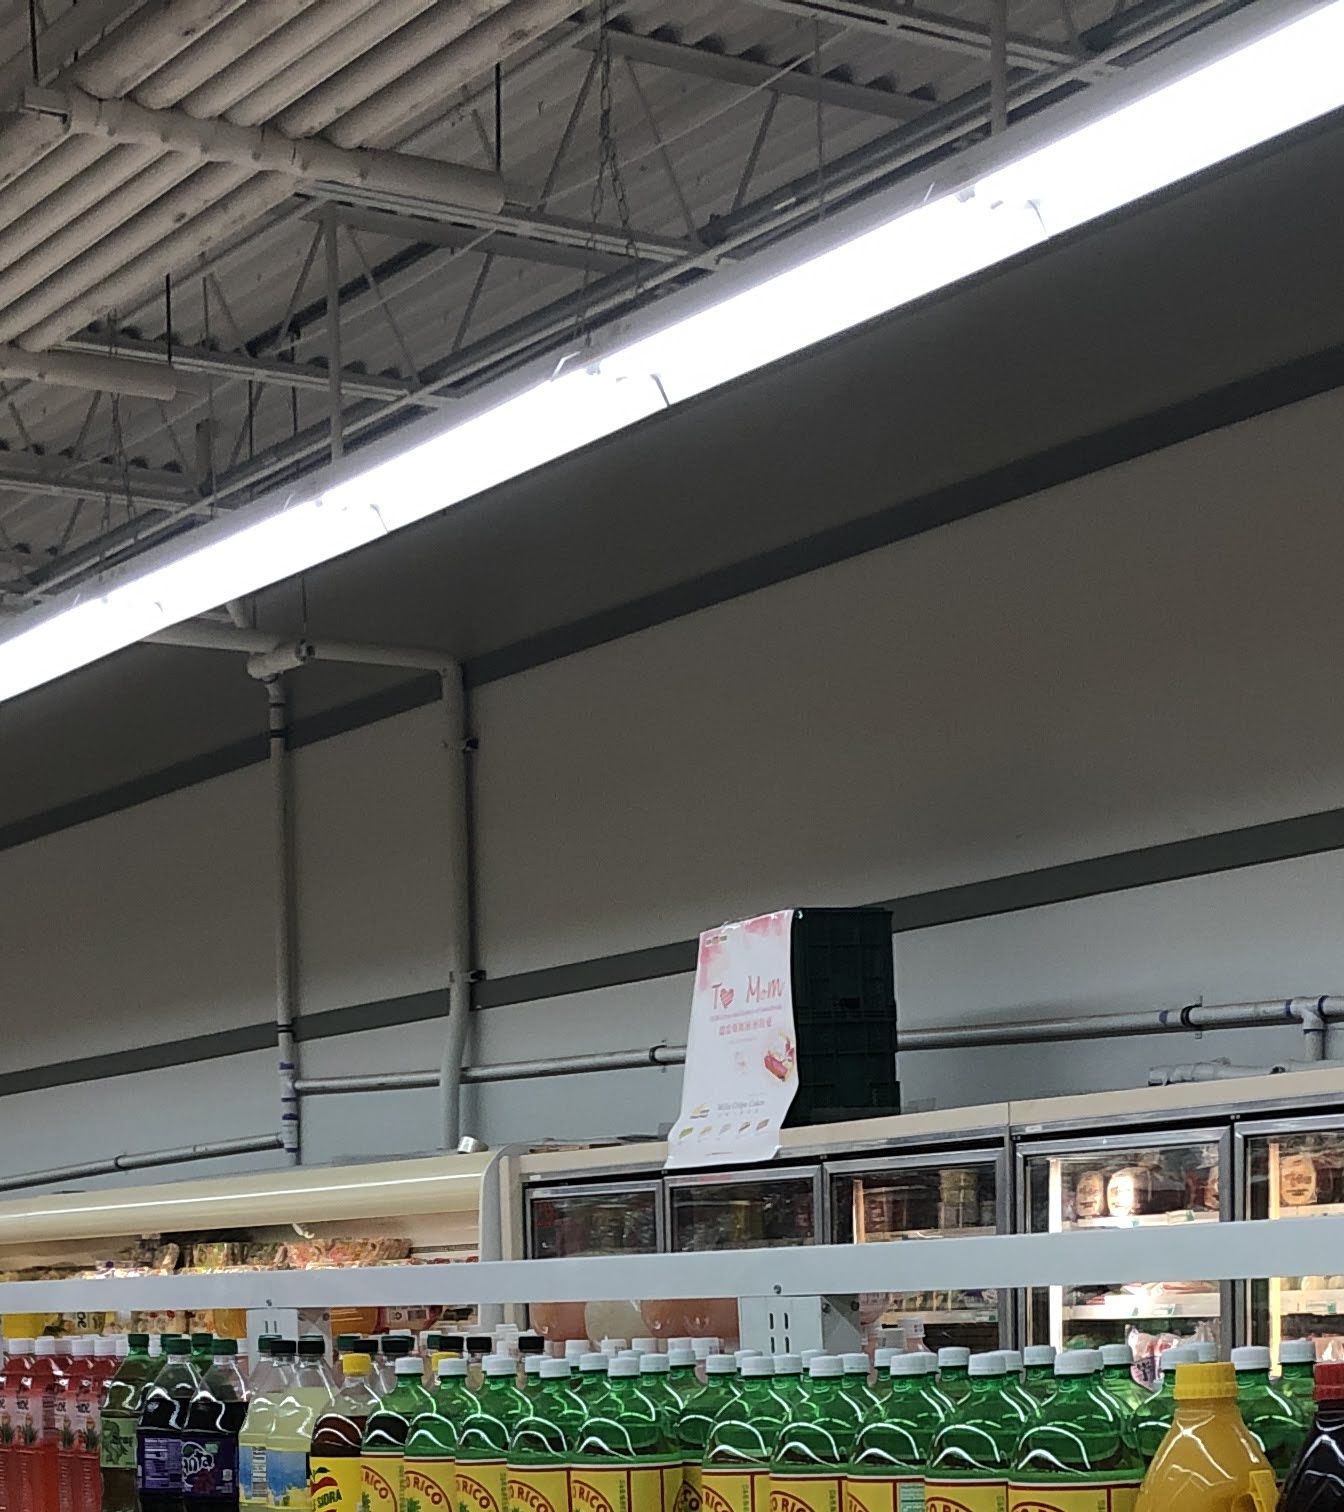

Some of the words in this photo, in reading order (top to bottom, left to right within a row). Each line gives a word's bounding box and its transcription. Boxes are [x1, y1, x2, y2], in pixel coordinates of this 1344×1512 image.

[363, 1469, 389, 1500] RICO
[413, 1477, 443, 1505] RICO
[459, 1479, 491, 1509] RICO
